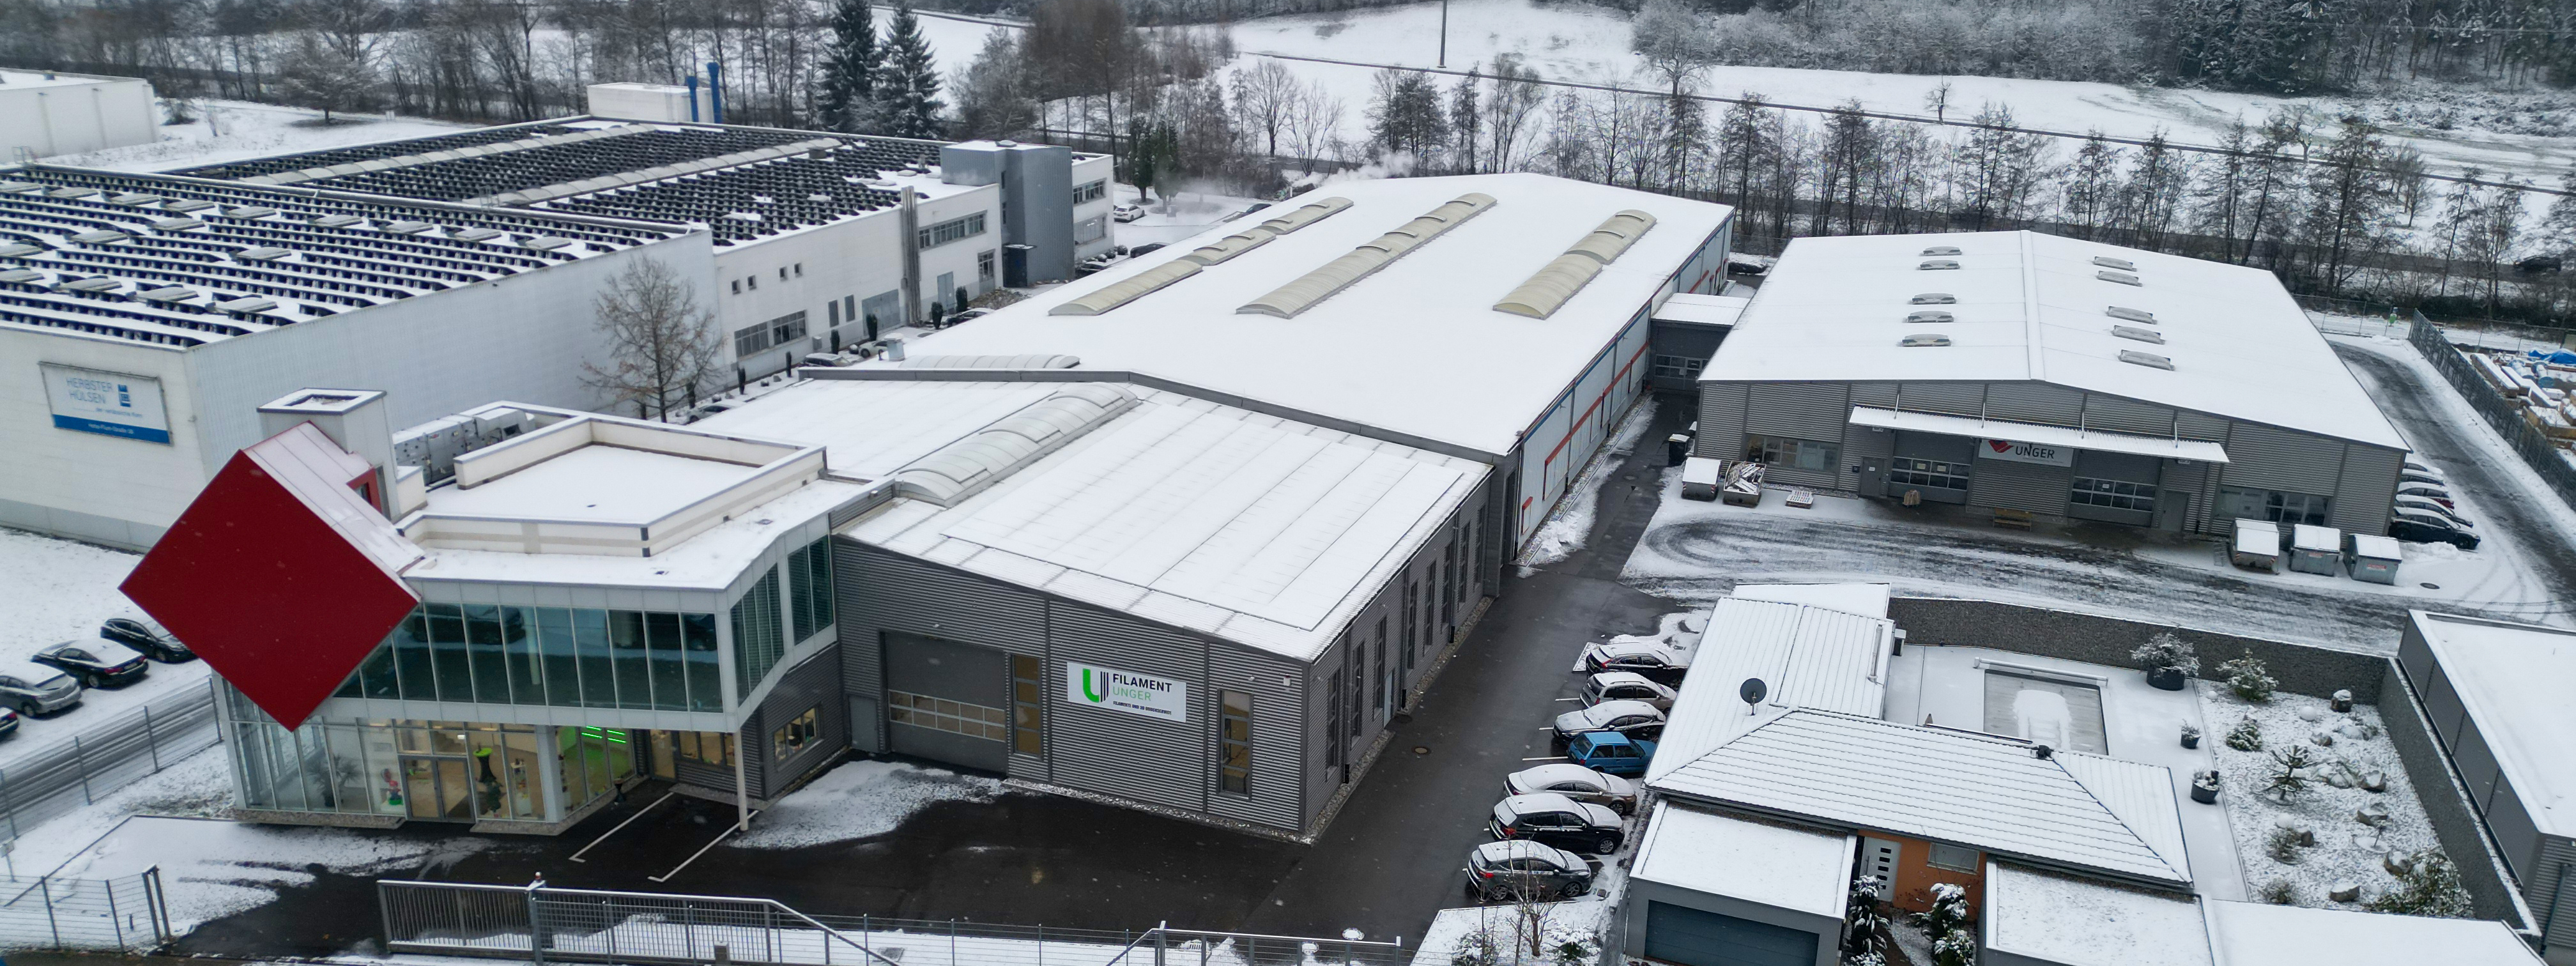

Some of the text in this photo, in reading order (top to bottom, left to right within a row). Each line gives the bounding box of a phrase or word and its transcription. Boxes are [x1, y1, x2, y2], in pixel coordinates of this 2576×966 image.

[2015, 446, 2055, 459] UNGER
[1112, 673, 1172, 693] FILAMENT
[1112, 686, 1152, 702] UNGER
